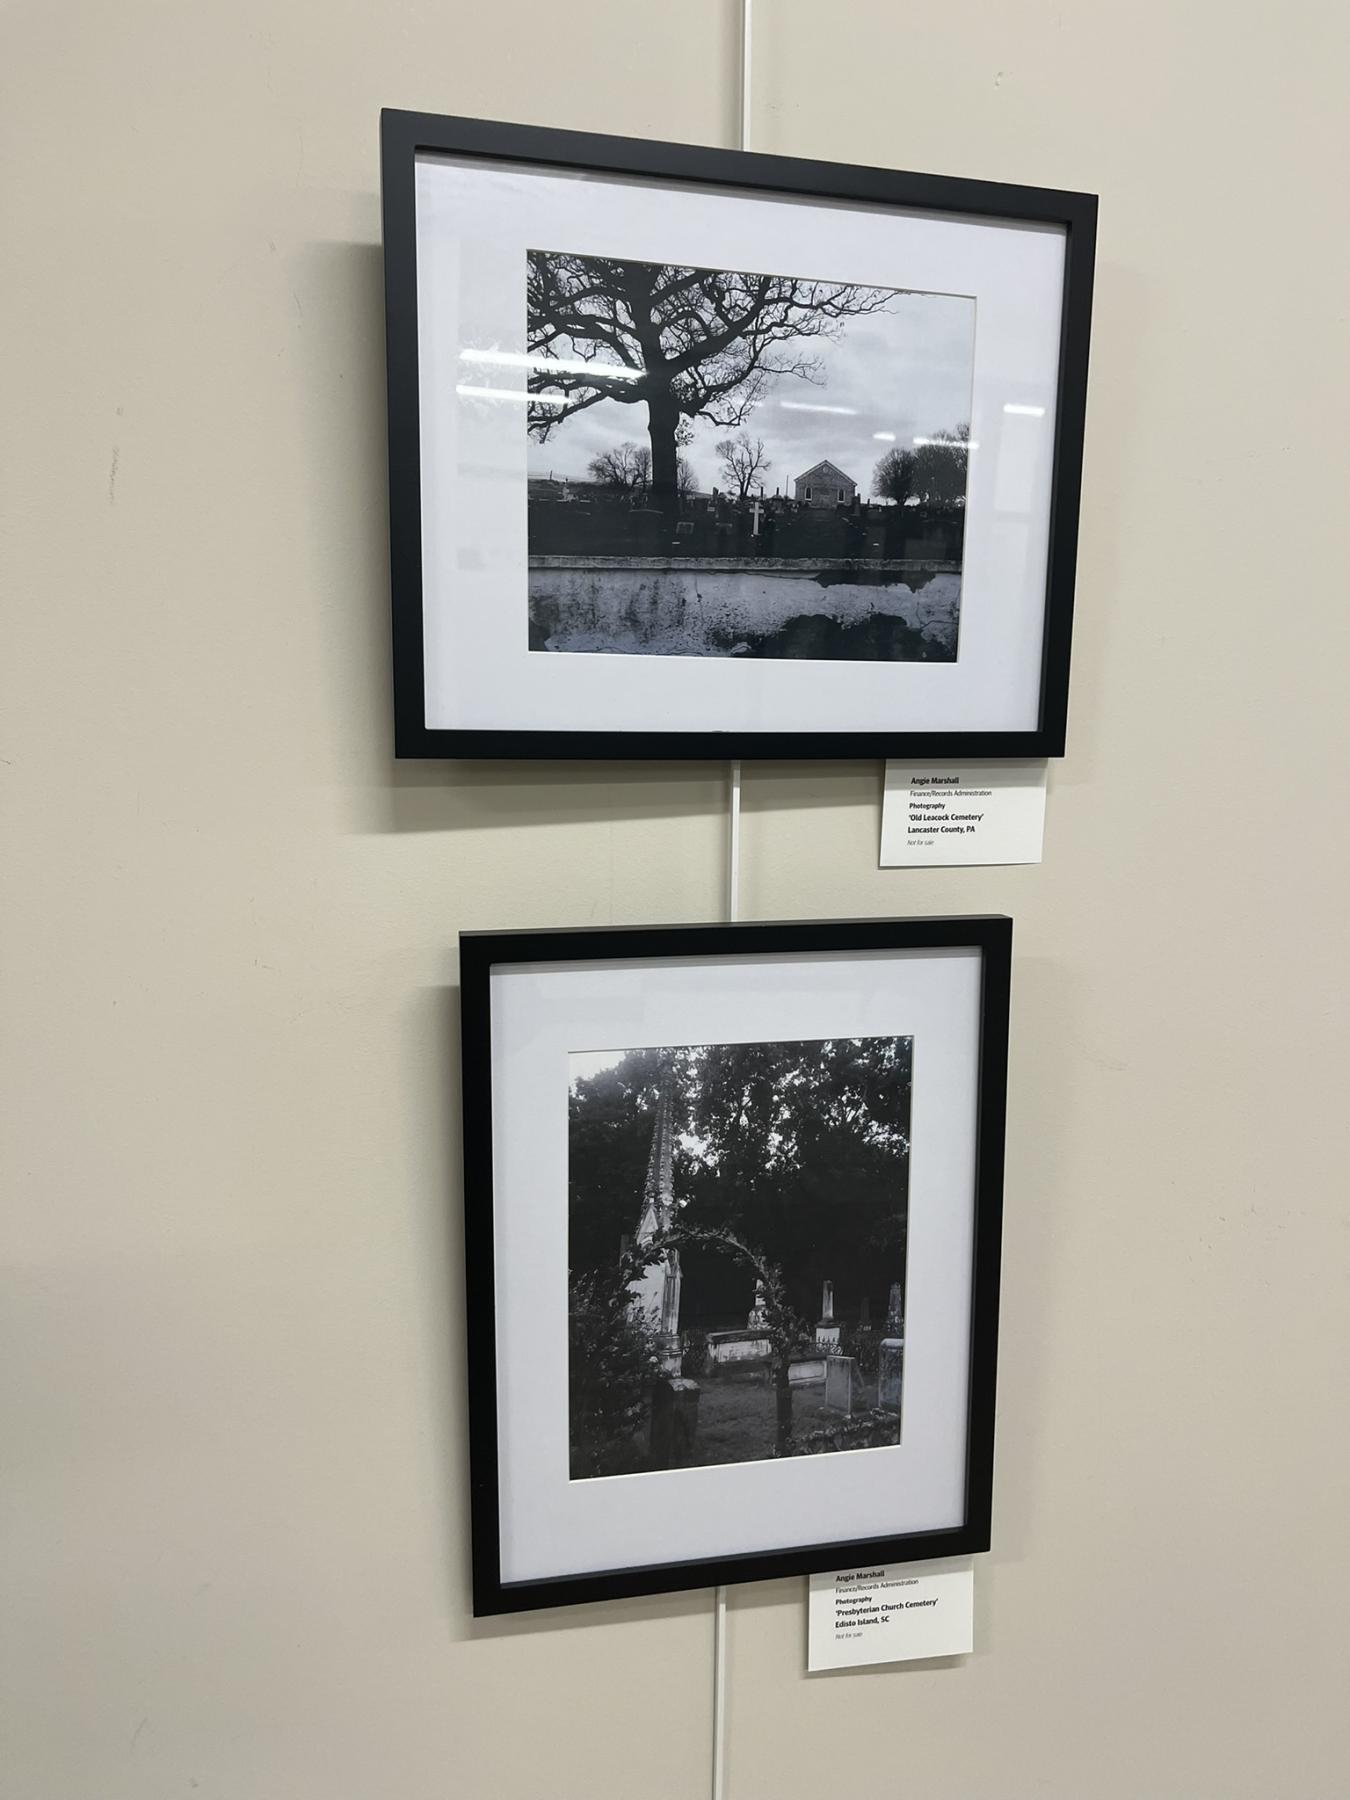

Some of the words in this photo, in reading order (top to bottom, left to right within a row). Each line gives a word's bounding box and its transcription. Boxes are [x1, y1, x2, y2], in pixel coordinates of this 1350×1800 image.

[911, 777, 930, 785] Angie
[856, 1570, 884, 1580] Marshall
[880, 1579, 919, 1588] Administration
[836, 1596, 872, 1605] Photography
[881, 1603, 904, 1611] Church
[835, 1620, 856, 1628] Edisto
[858, 1617, 879, 1626] Island,
